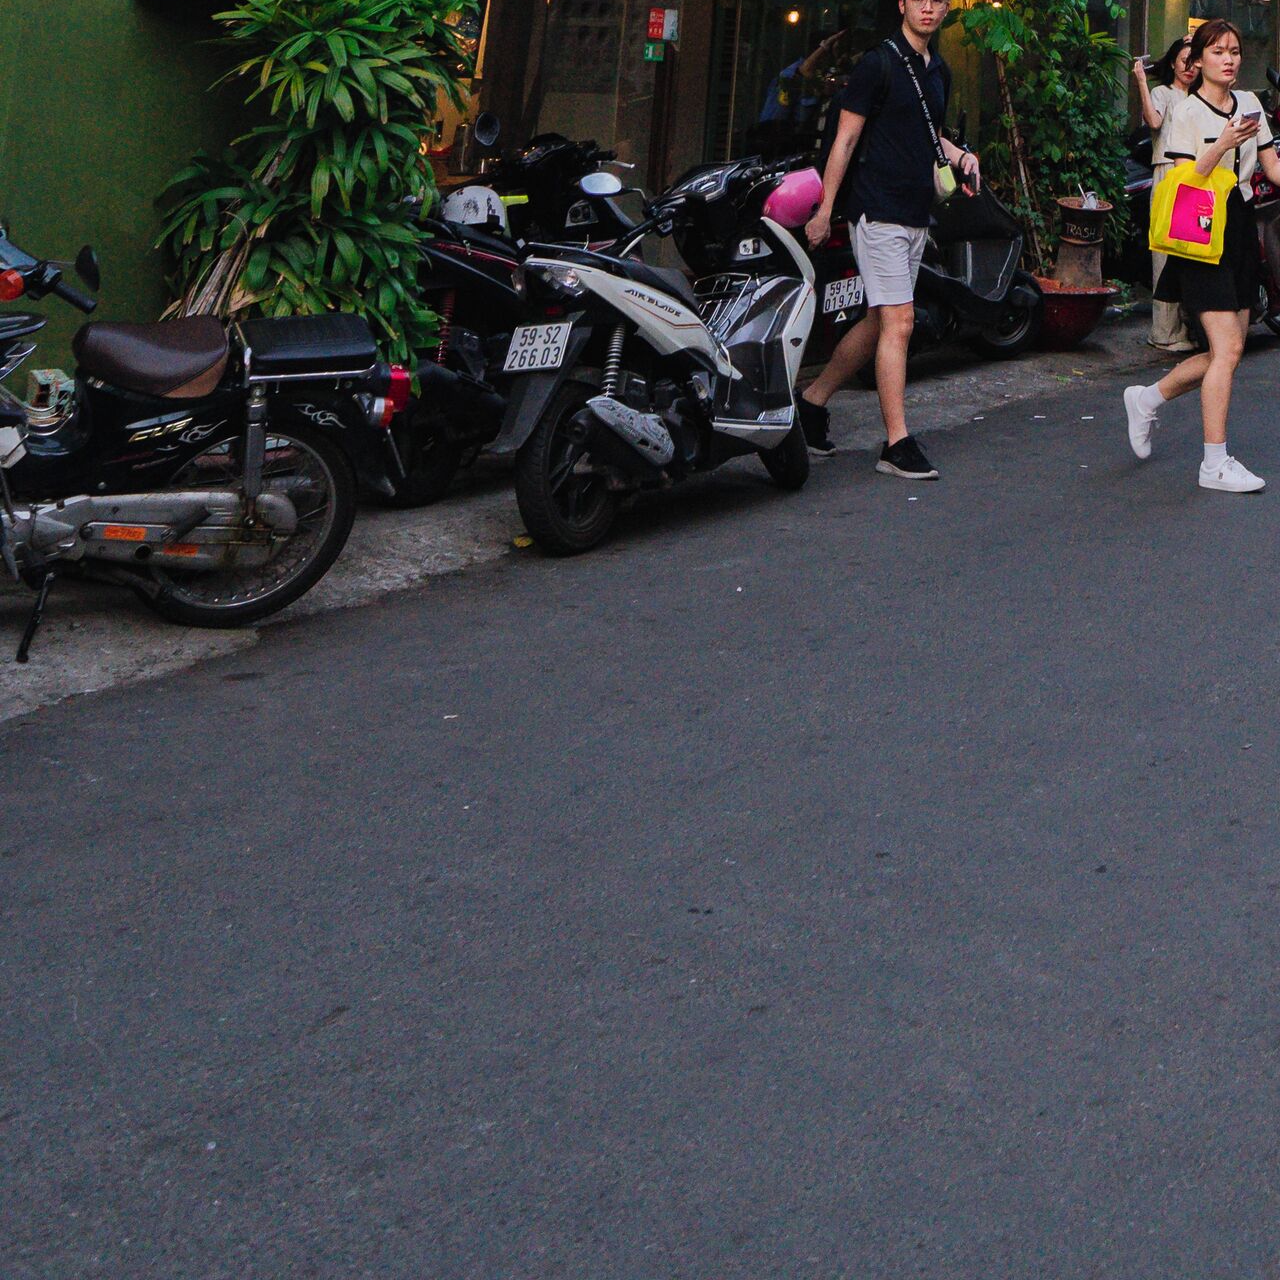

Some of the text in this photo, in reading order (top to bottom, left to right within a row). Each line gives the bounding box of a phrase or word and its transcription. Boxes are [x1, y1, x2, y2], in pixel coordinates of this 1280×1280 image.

[1065, 222, 1097, 240] TRASH
[830, 277, 858, 297] 59-F1
[824, 290, 861, 312] 019.79
[519, 325, 562, 348] 59-S2
[507, 346, 562, 370] 266.03
